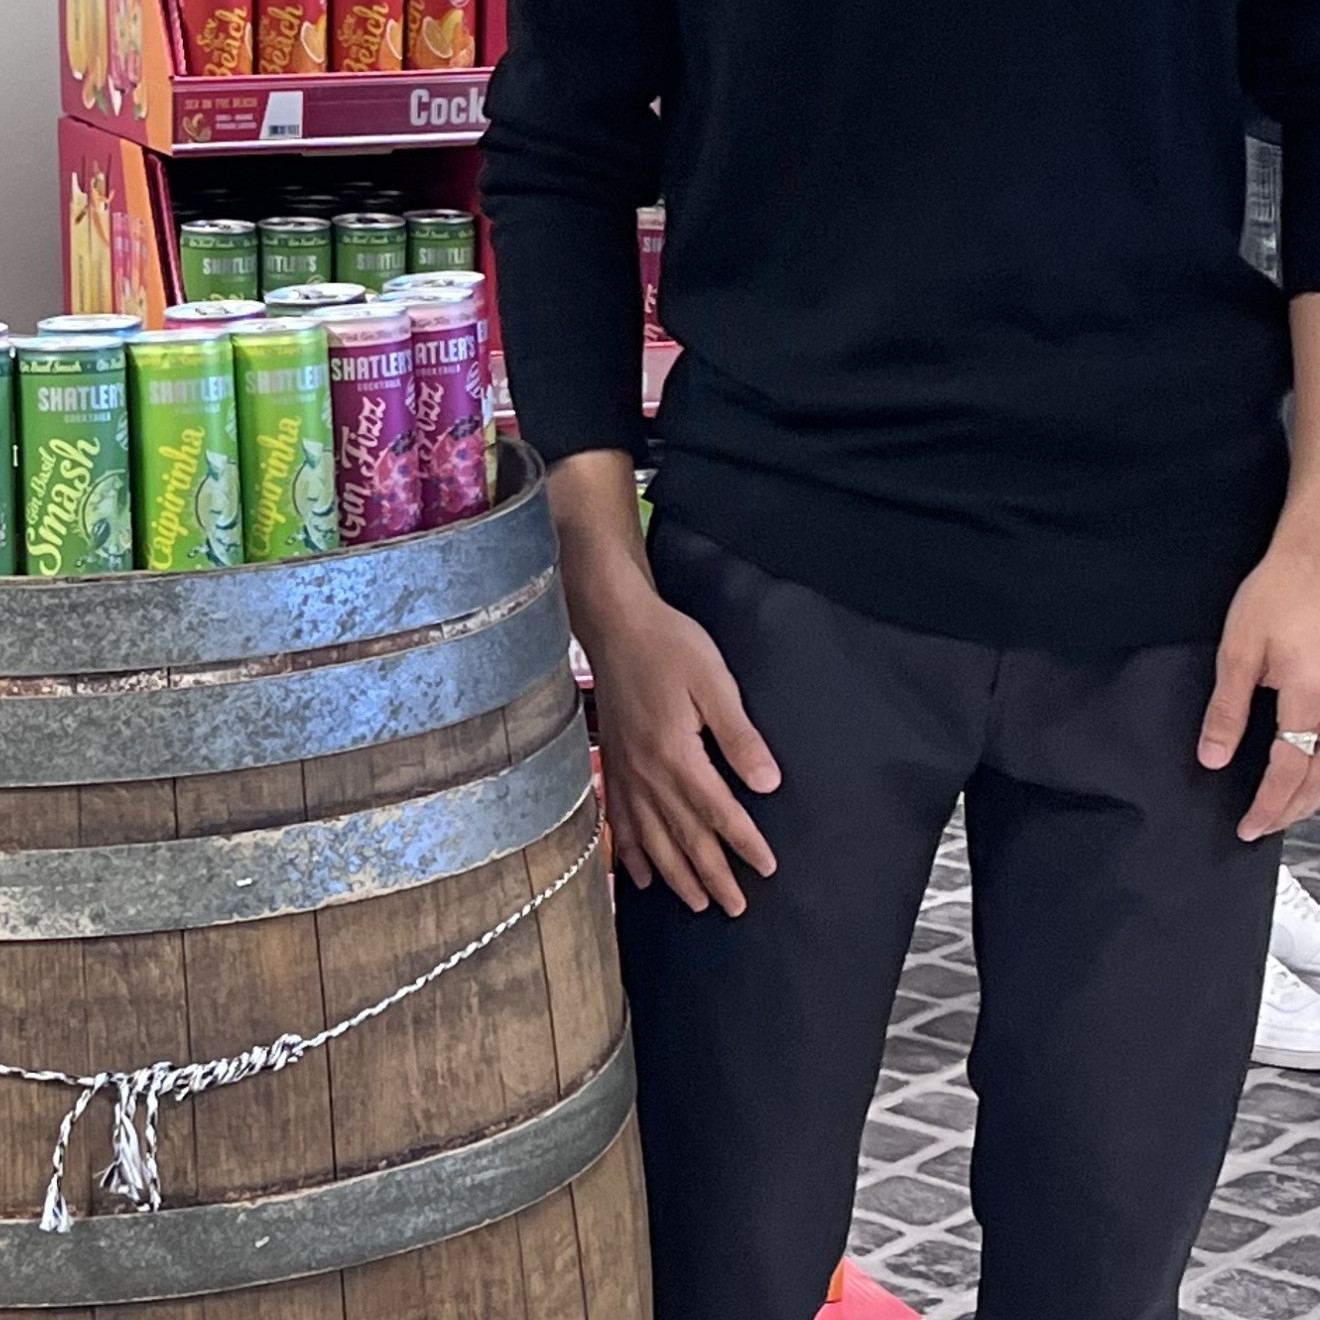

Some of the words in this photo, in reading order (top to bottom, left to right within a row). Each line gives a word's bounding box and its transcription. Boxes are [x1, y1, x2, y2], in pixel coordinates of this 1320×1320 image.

[415, 335, 476, 366] ATLER'S
[341, 396, 386, 477] Fizz
[26, 437, 101, 576] Smash
